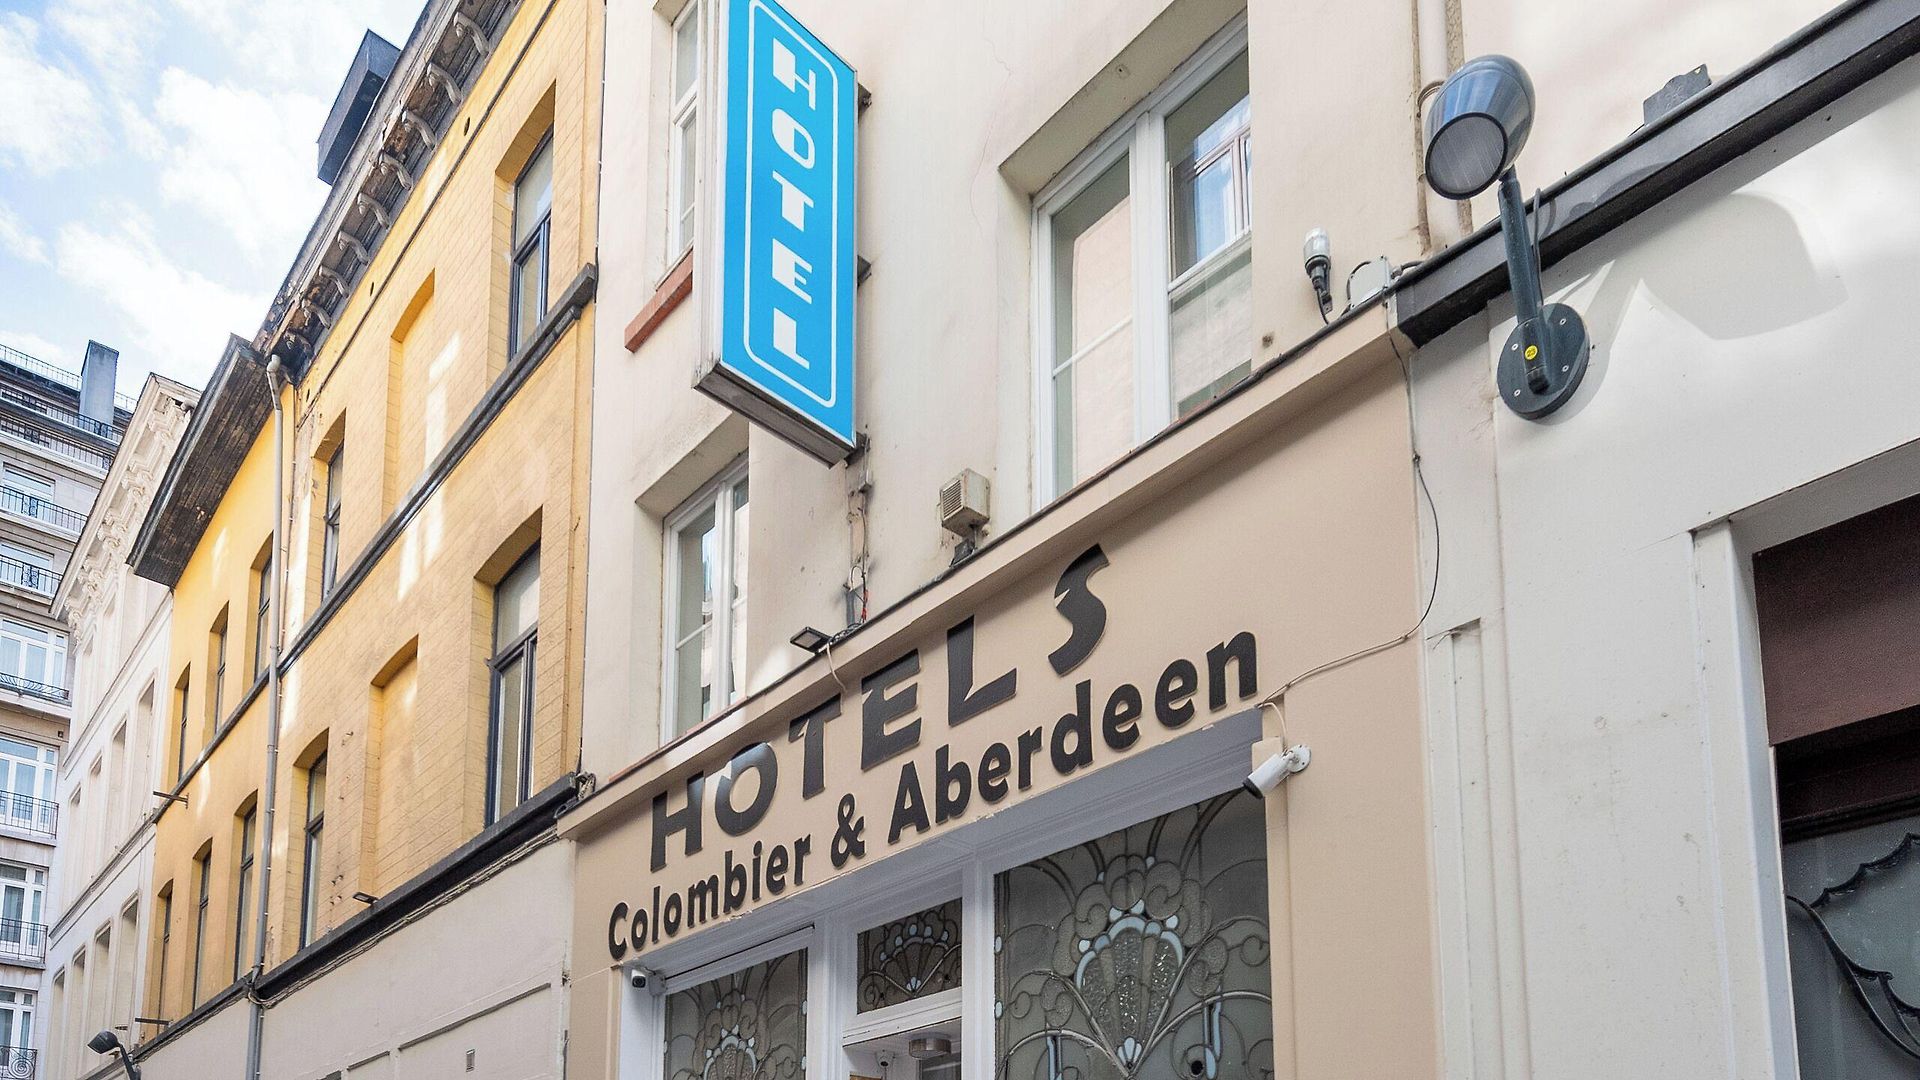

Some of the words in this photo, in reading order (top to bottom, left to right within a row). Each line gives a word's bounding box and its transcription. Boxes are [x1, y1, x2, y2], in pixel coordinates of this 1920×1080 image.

[772, 37, 816, 371] HOTEL
[608, 833, 812, 961] Colombier
[831, 793, 867, 869] &
[887, 631, 1258, 845] Aberdeen
[650, 543, 1111, 873] HOTELS
